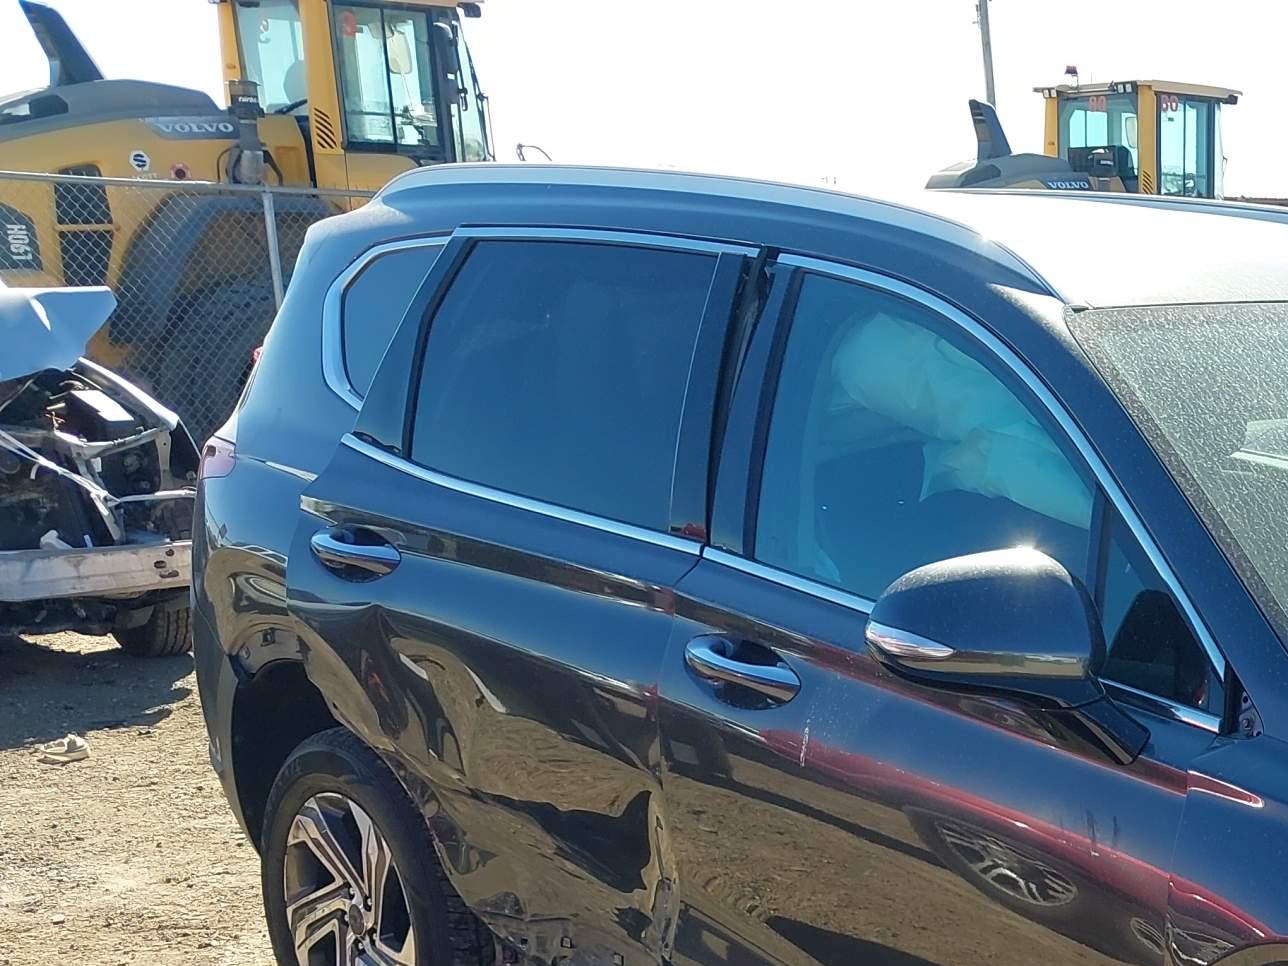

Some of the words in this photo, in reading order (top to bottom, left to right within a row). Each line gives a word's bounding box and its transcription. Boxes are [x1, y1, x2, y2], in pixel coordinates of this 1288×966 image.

[157, 123, 234, 133] VOLVO
[1047, 181, 1089, 190] VOLVO
[6, 224, 33, 260] L90H
